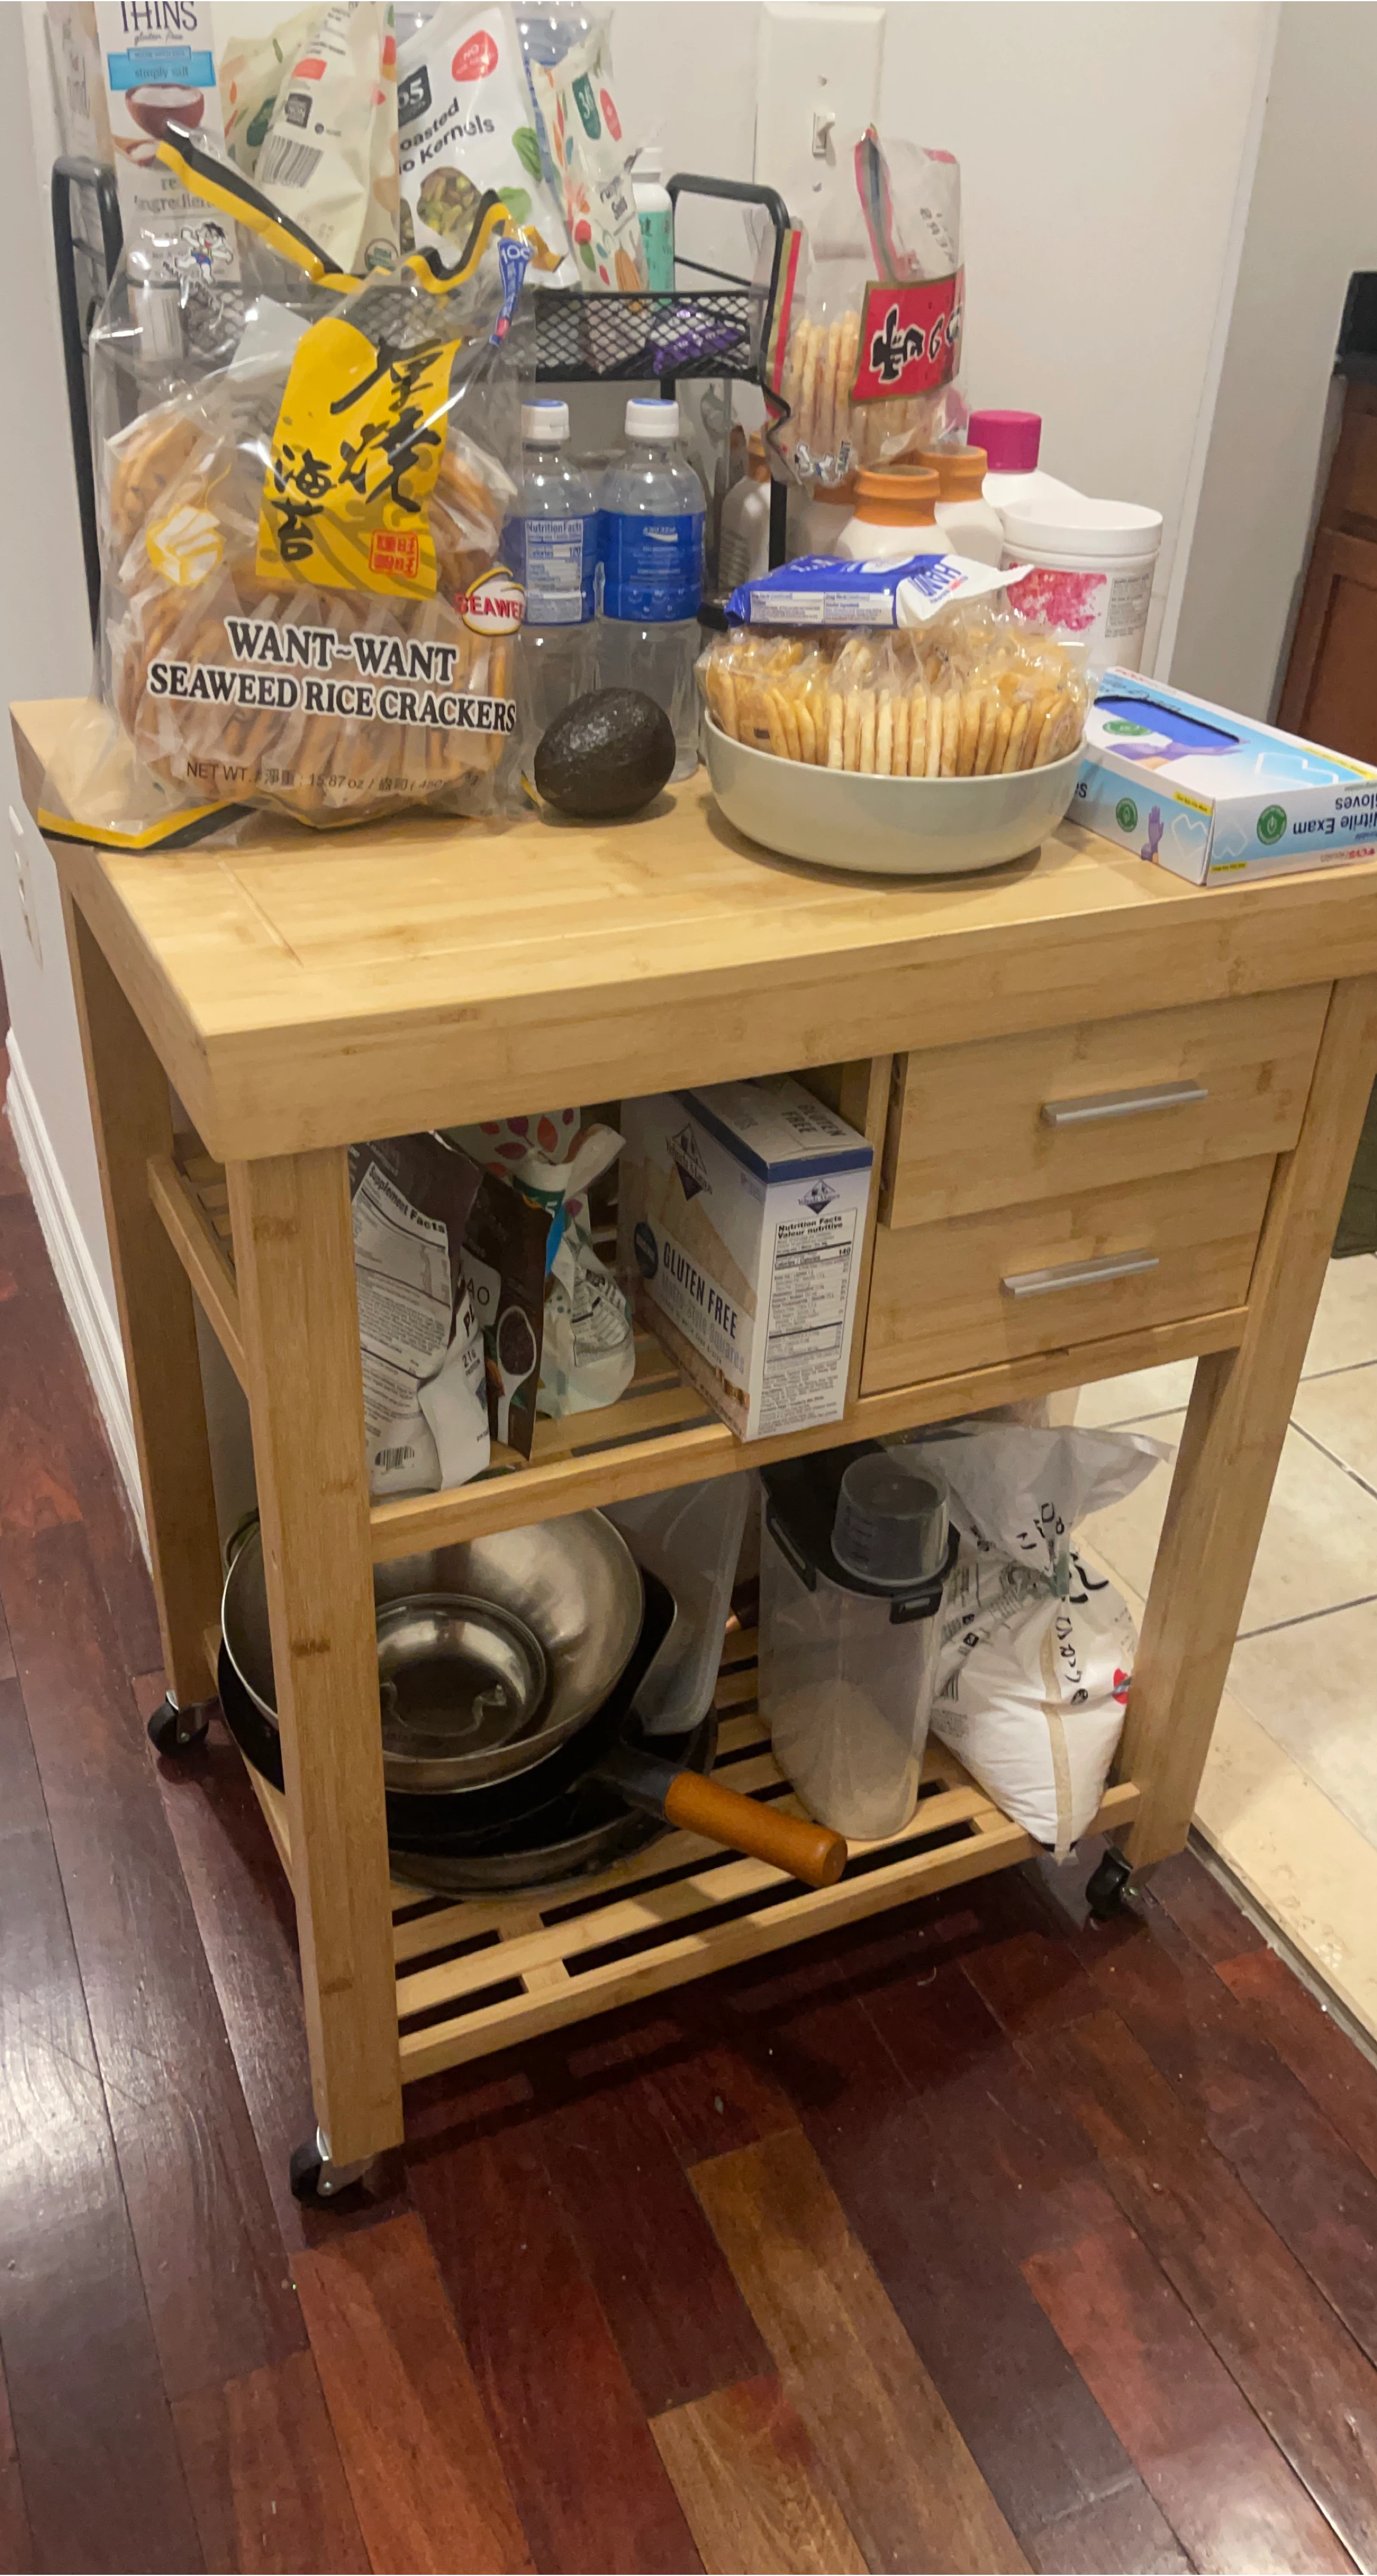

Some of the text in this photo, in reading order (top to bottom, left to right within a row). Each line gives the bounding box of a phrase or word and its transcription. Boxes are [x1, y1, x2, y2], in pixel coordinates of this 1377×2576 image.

[135, 66, 168, 79] simply
[420, 114, 495, 164] Kernels
[150, 663, 517, 734] SEAWEED RICE CRACKERS
[187, 761, 219, 780] NET
[1292, 817, 1335, 835] Exam
[368, 1165, 446, 1234] Supplement Facts
[778, 1222, 843, 1239] Valeur nutritive
[779, 1215, 842, 1233] Nutrition Facts
[663, 1241, 705, 1306] GLUTEN
[707, 1287, 737, 1340] FREE
